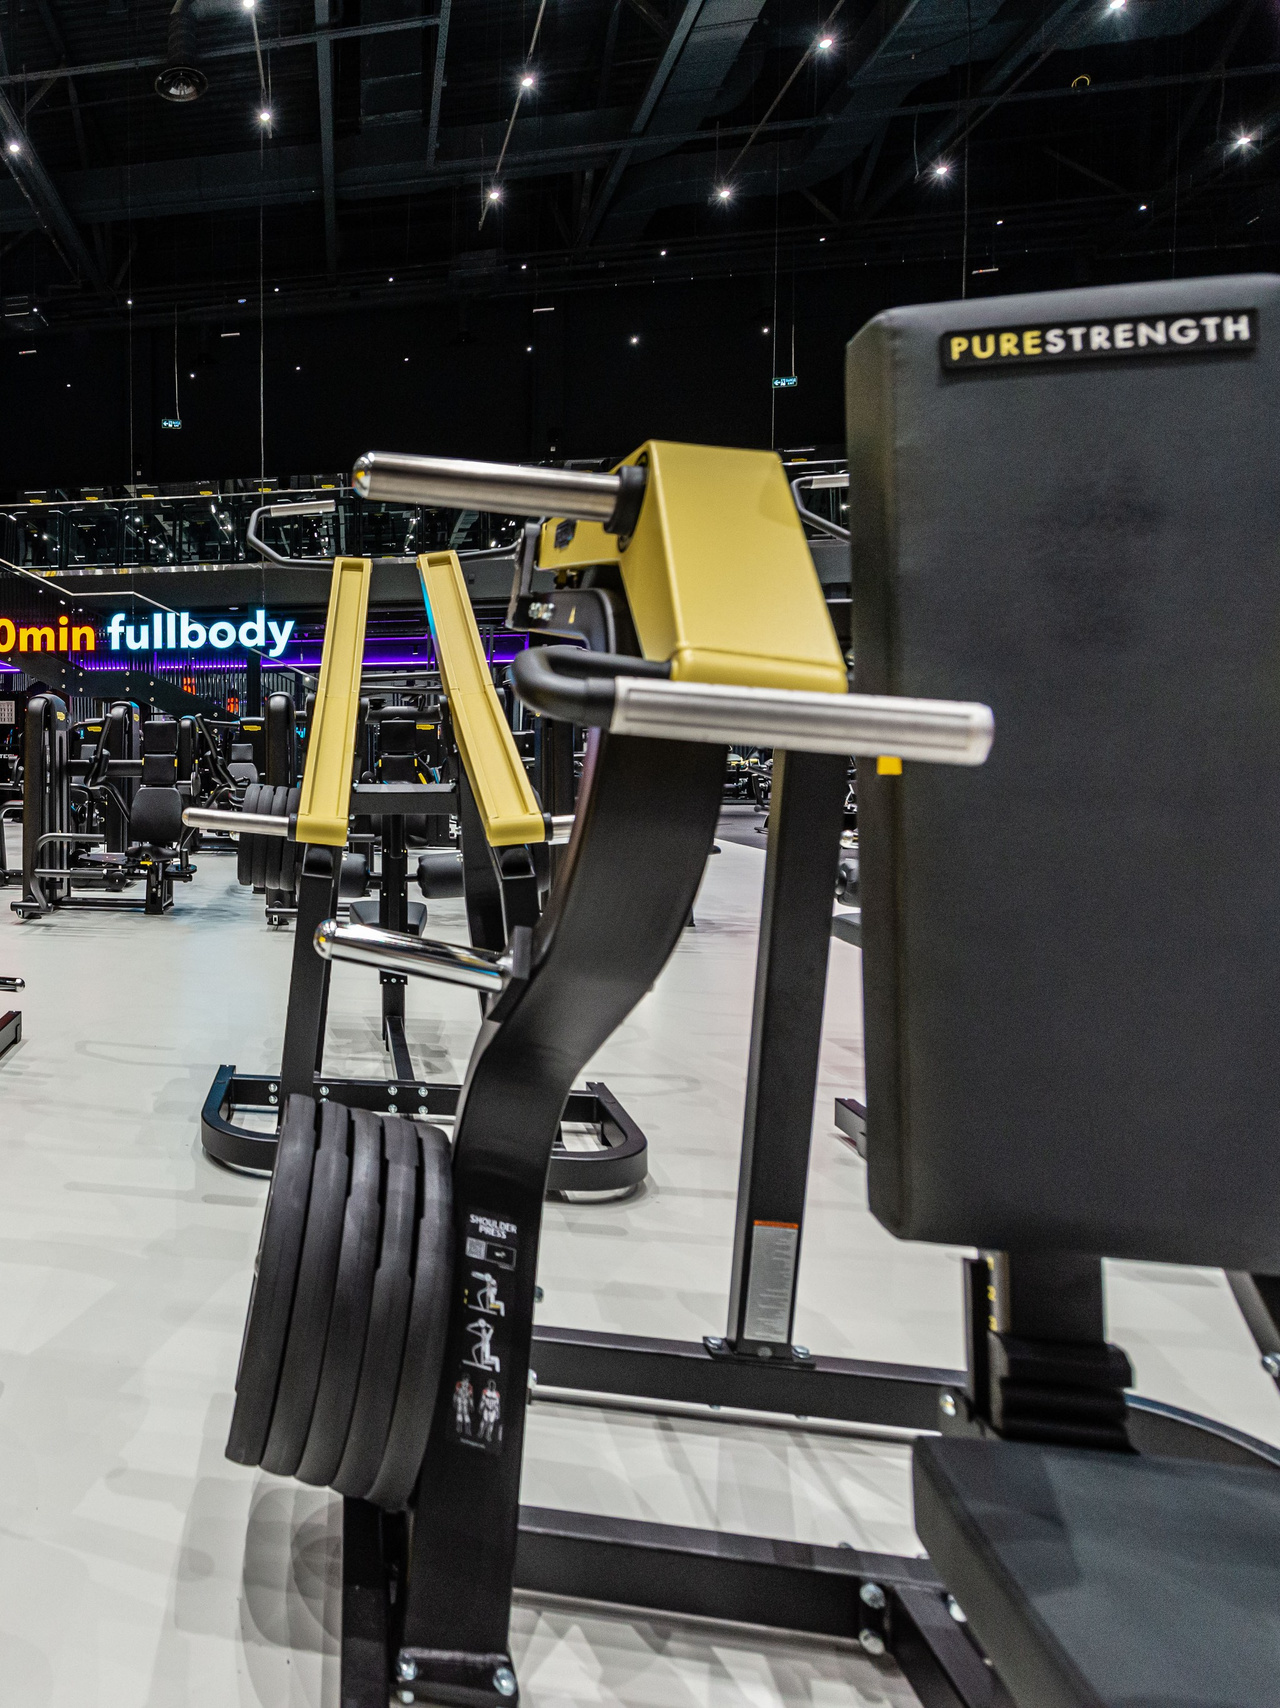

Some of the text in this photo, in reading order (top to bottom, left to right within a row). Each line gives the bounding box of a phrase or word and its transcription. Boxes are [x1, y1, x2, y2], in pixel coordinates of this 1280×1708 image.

[950, 314, 1250, 361] PURESTRENGTH
[106, 609, 296, 658] fullbody
[469, 1213, 518, 1235] SHOULDER
[478, 1224, 507, 1239] PRESS
